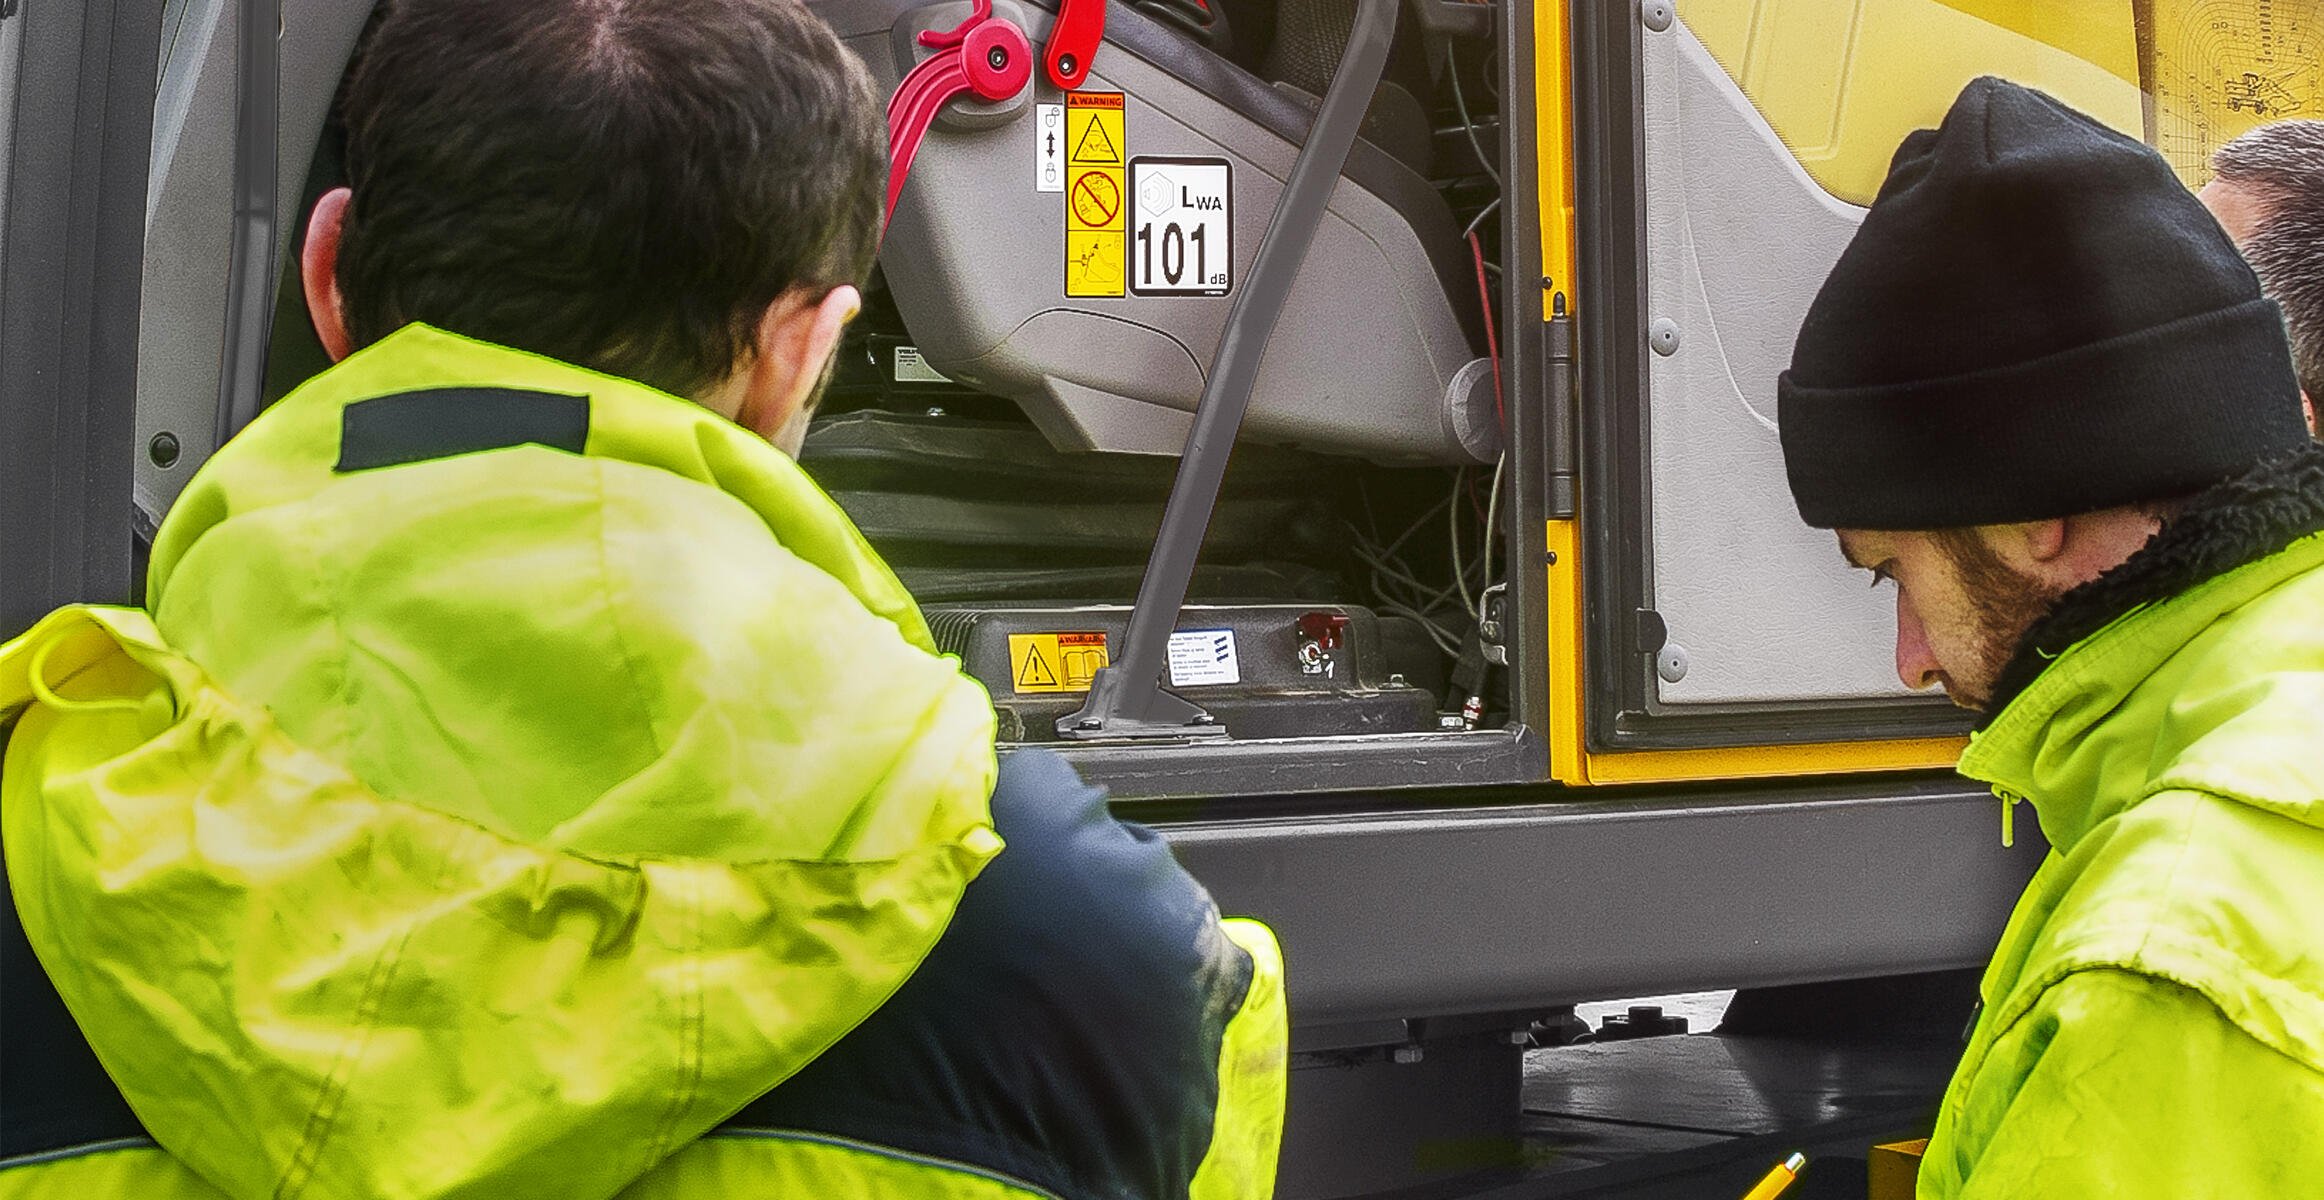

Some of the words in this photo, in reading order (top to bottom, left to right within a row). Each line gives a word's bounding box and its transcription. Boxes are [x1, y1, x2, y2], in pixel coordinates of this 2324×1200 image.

[1079, 96, 1122, 107] WARNING
[1138, 221, 1206, 286] 101
[1210, 273, 1227, 285] dB
